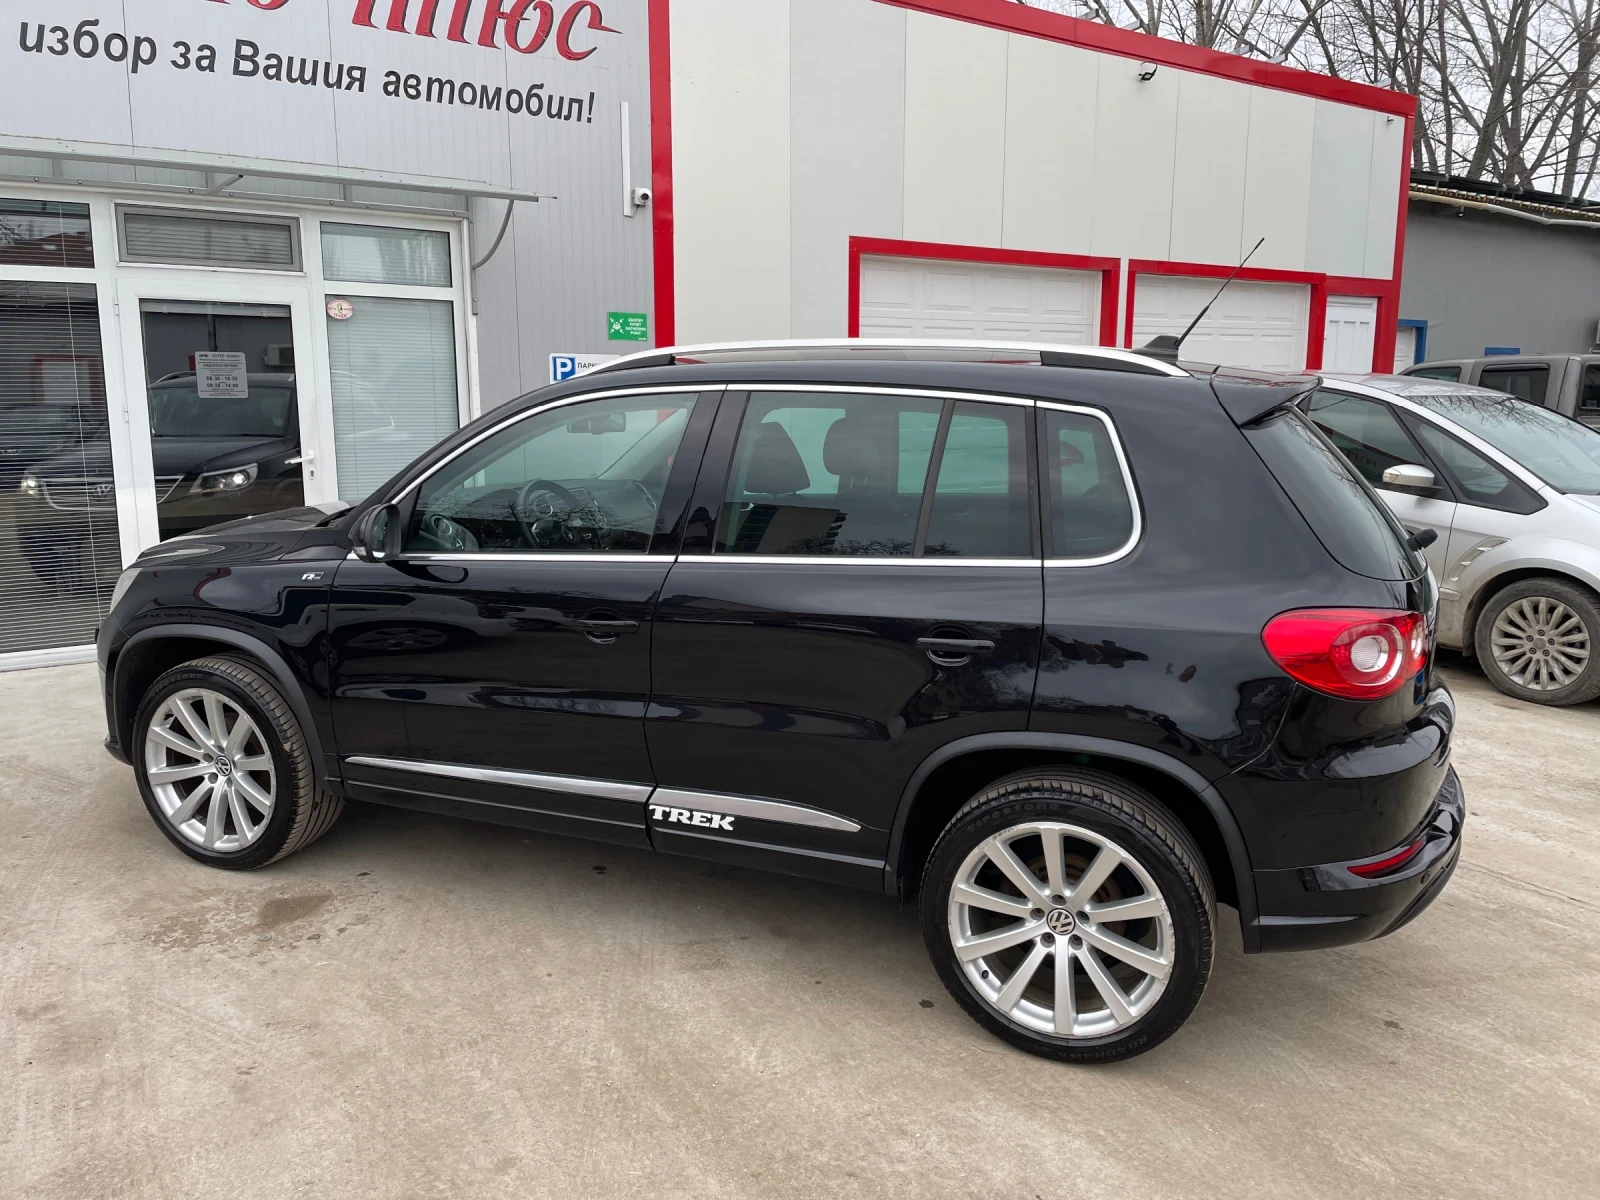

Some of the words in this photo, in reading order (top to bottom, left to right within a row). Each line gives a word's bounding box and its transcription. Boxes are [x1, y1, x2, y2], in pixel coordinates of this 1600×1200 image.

[19, 18, 157, 74] избор
[170, 40, 217, 73] за
[232, 38, 367, 93] Вашия
[382, 70, 596, 125] автомобил!
[555, 358, 573, 381] P
[648, 804, 735, 831] TREK
